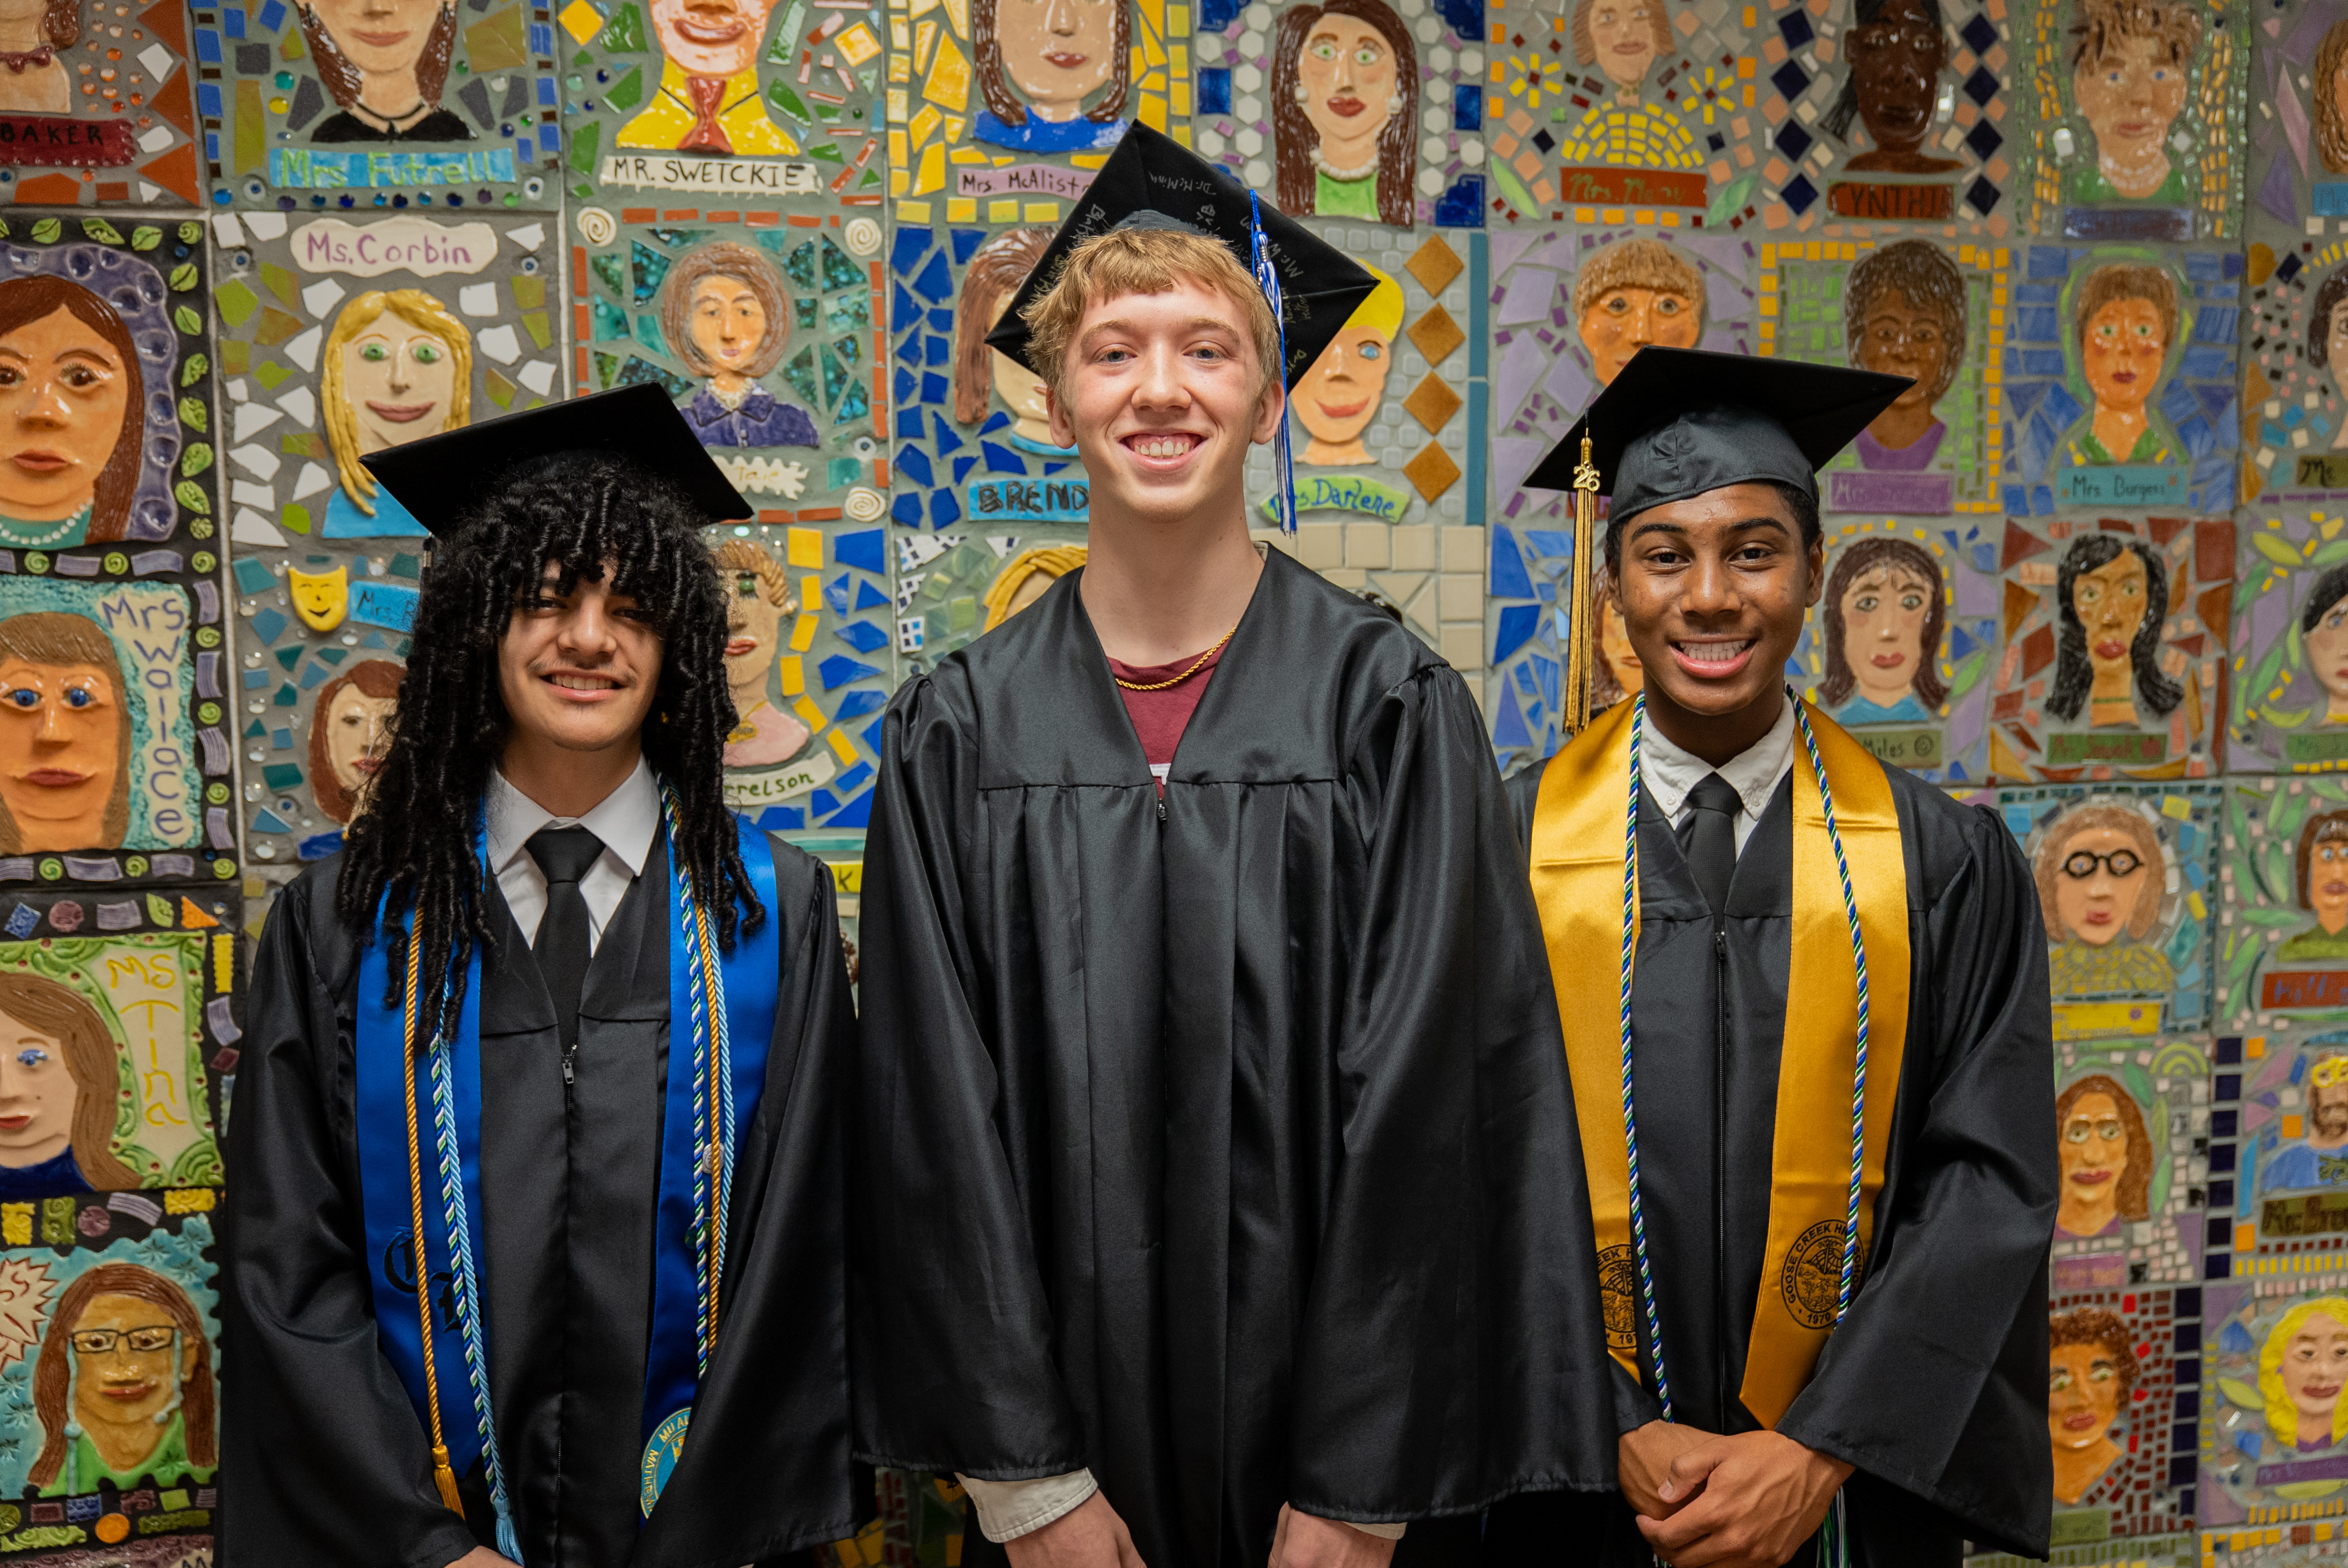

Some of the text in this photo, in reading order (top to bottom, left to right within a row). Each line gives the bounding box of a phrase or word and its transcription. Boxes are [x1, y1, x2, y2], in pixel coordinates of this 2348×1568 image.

[0, 122, 104, 146] BAKER
[281, 148, 496, 188] Mrs Futrell
[614, 157, 806, 187] MR. SWETCKIE
[1573, 466, 1600, 492] 26
[1311, 478, 1397, 519] Darlene
[1785, 1255, 1799, 1304] GOOSE
[1795, 1223, 1832, 1253] CREEK
[1806, 1311, 1831, 1325] 1970
[658, 1422, 676, 1443] MU
